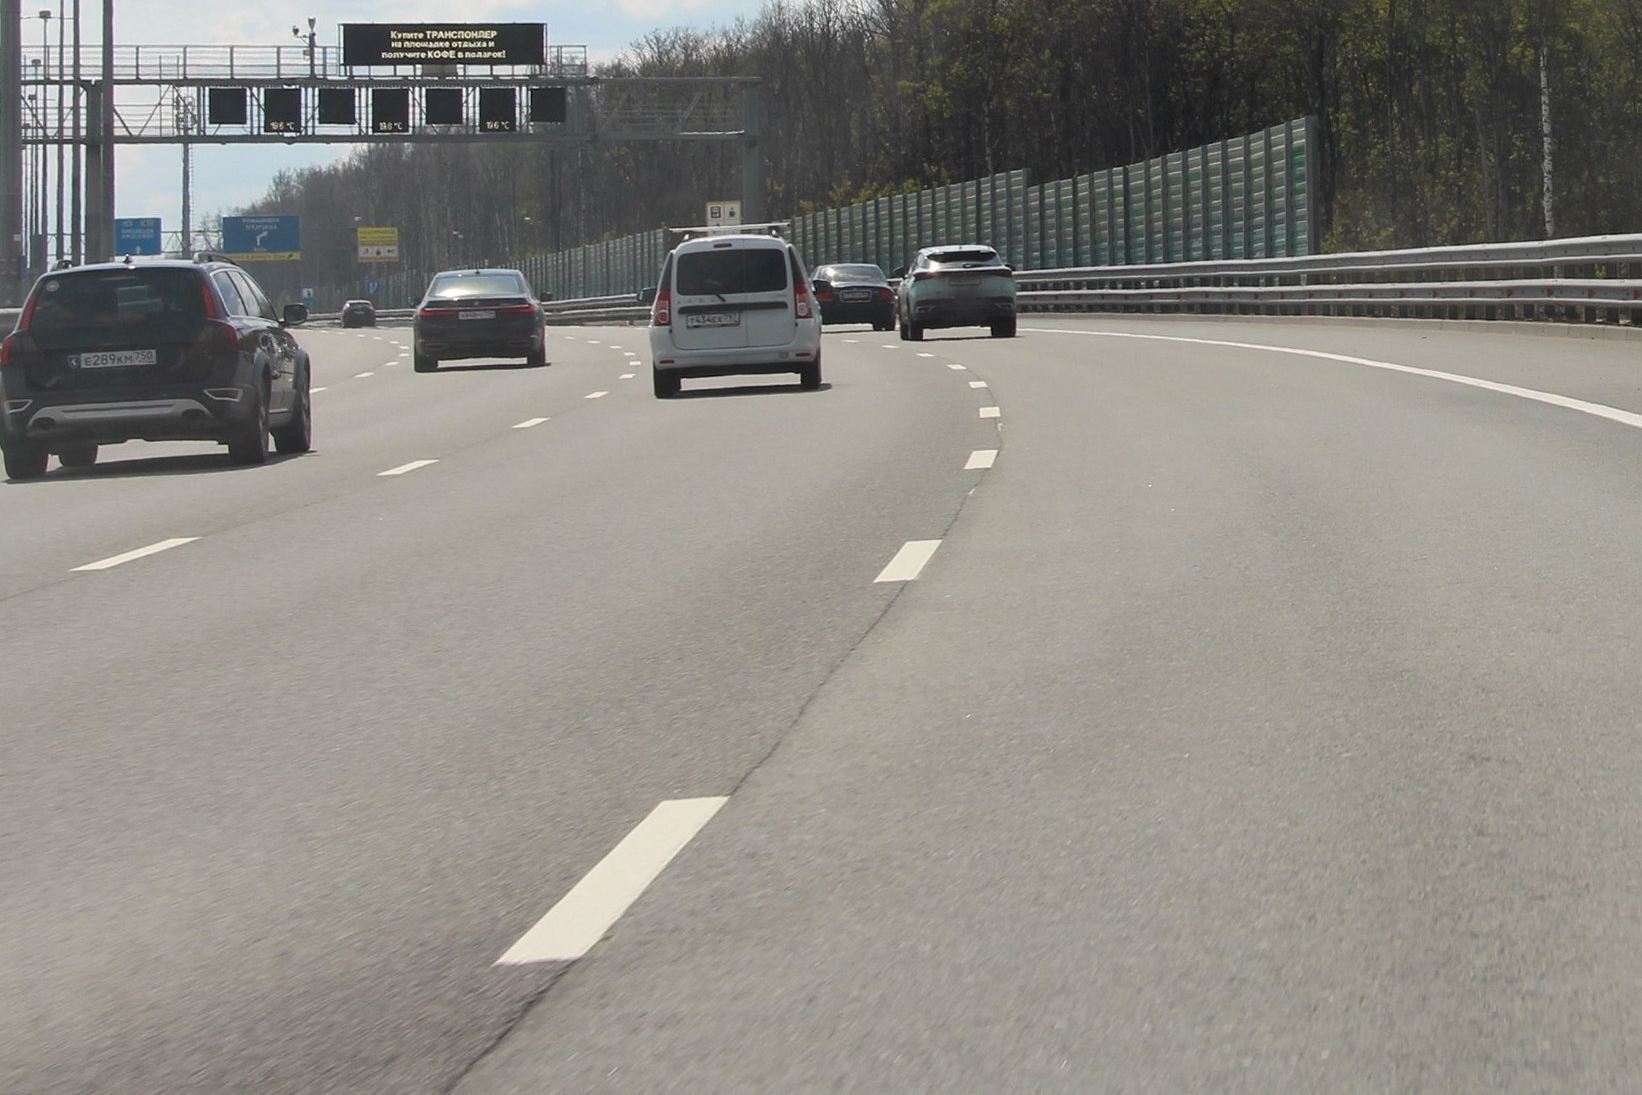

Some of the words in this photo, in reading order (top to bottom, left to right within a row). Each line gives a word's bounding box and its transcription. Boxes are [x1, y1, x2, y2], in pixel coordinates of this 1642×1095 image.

[391, 30, 424, 40] Купите
[426, 30, 497, 39] ТРАНСПОНДЕР
[404, 41, 450, 49] площадке
[381, 51, 426, 59] получите
[427, 50, 456, 59] КОФЕ
[465, 50, 506, 60] подарок!
